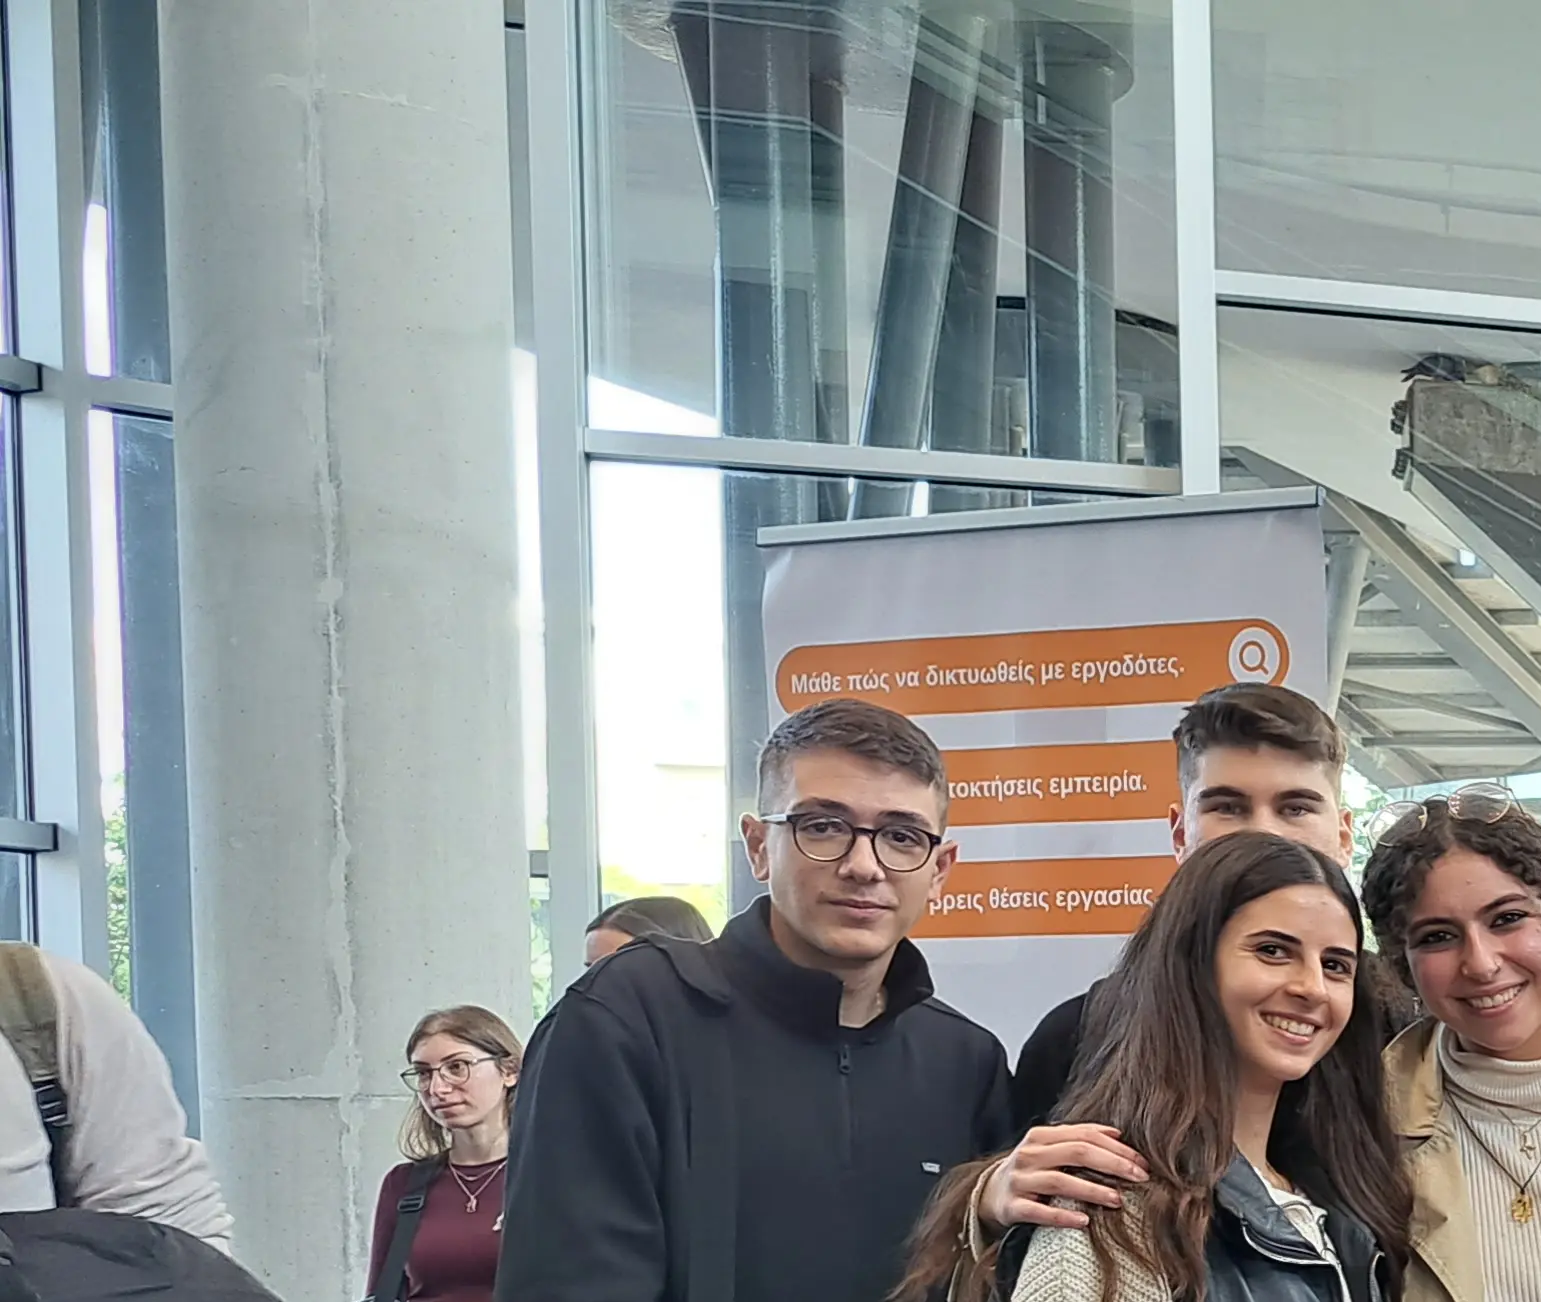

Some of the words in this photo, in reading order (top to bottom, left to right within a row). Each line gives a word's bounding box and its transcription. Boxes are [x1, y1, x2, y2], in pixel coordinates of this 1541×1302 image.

[791, 670, 842, 694] Μάθε
[847, 667, 891, 693] πώς
[894, 670, 920, 688] να
[925, 657, 1035, 686] δικτυωθείς
[1040, 660, 1066, 686] με
[1071, 653, 1186, 684] εργοδότες.
[1049, 769, 1148, 799] εμπειρία.
[989, 886, 1050, 913] θέσεις
[1055, 884, 1154, 912] εργασίας
